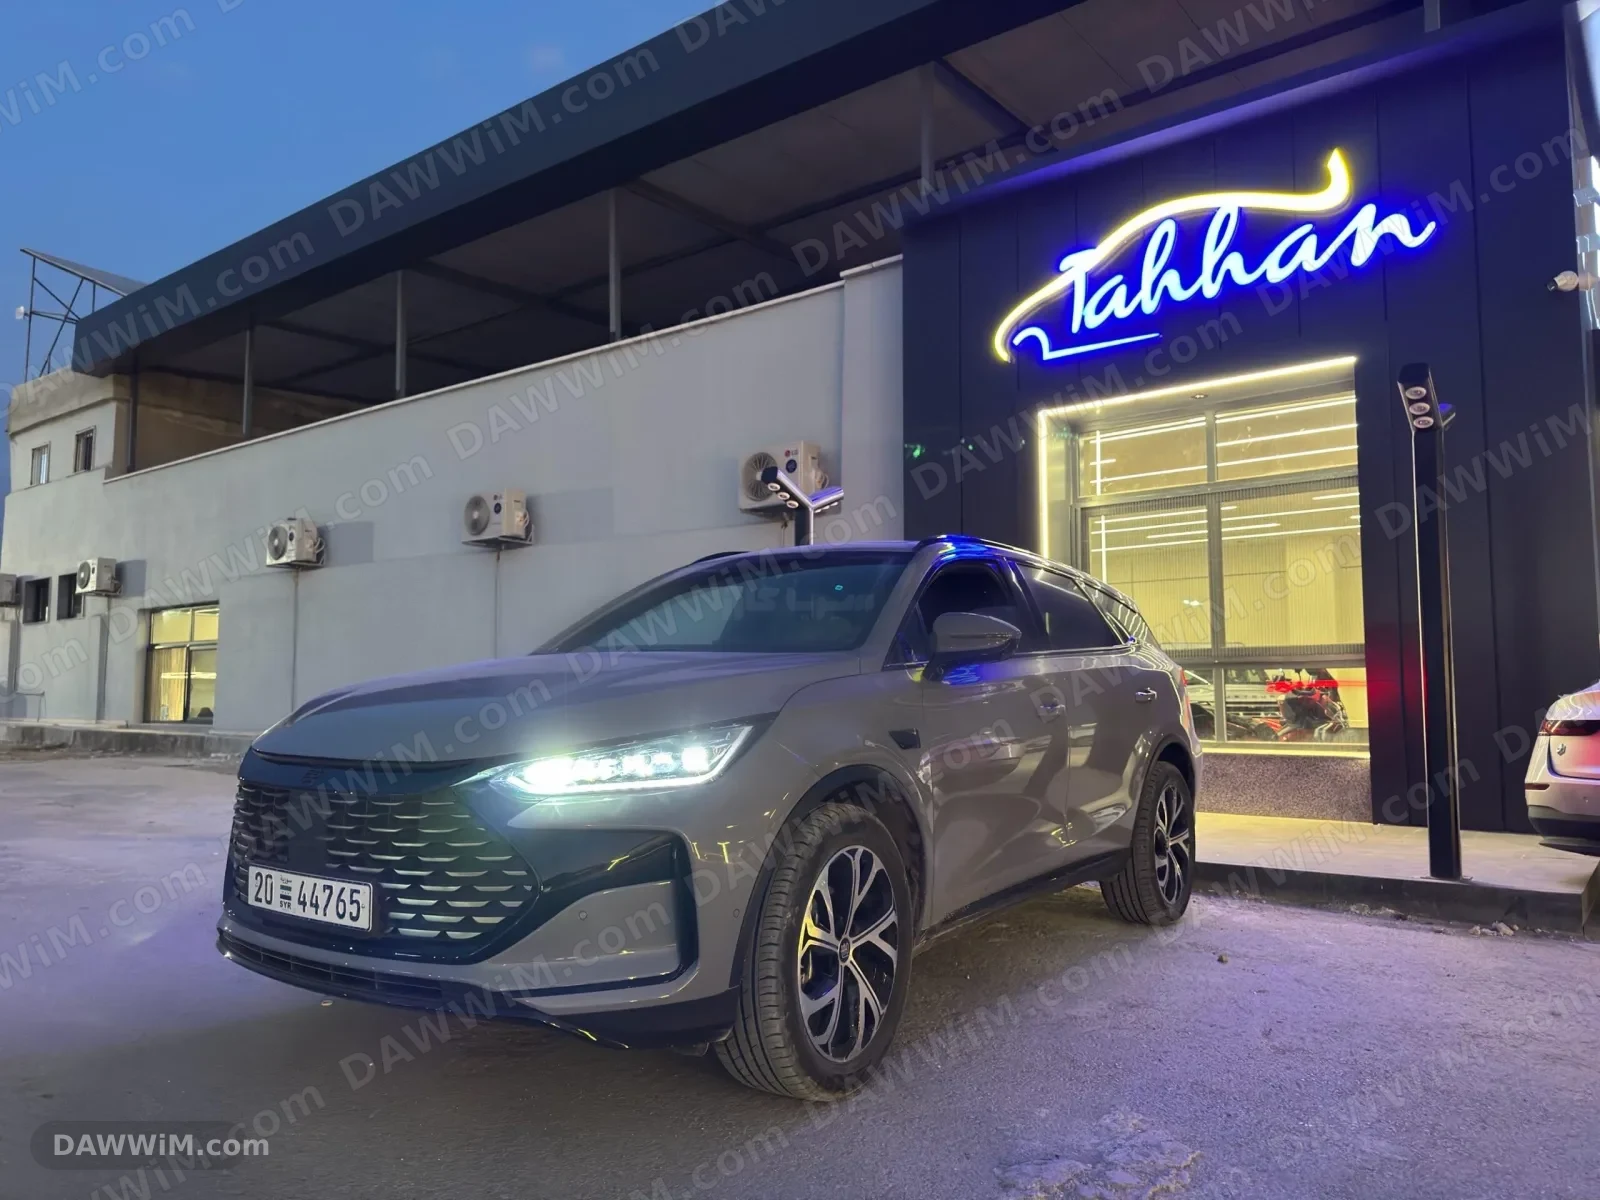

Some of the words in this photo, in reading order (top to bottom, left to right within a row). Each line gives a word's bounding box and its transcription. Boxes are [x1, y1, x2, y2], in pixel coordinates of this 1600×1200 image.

[1059, 202, 1437, 334] Tahhan
[254, 871, 274, 905] 20
[297, 880, 361, 922] 44765
[280, 899, 292, 909] SYR
